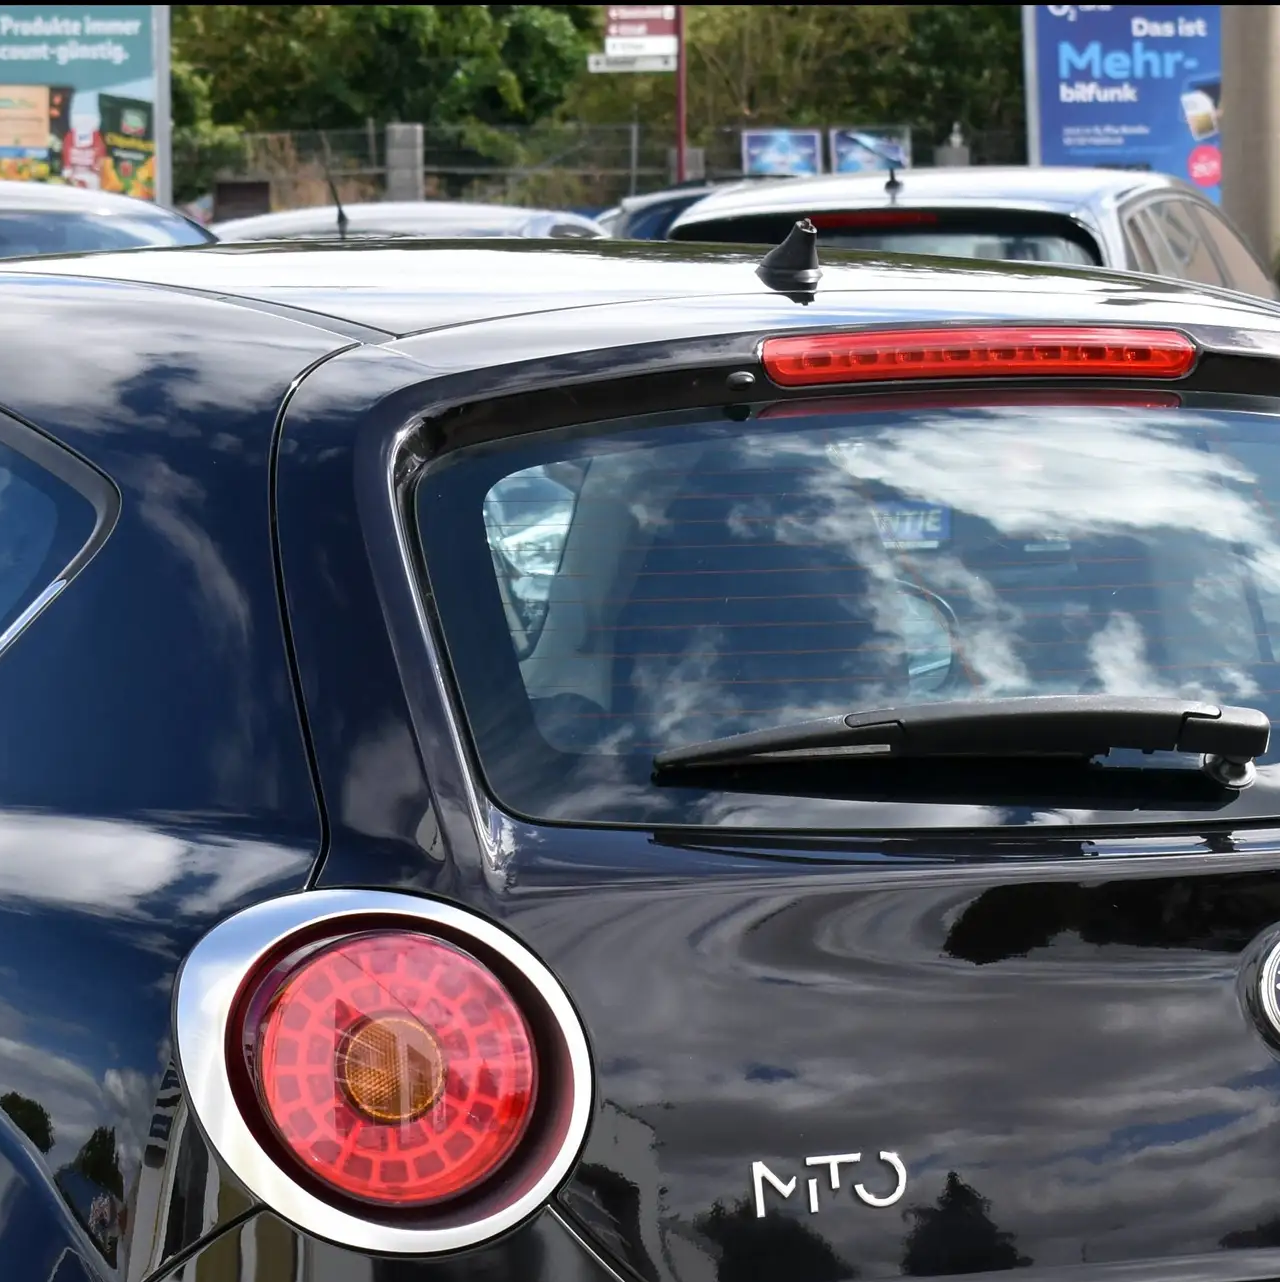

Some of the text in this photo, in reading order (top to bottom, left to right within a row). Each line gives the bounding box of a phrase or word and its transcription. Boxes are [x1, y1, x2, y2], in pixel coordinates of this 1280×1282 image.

[0, 14, 82, 36] Produkte
[83, 13, 142, 36] immer
[1131, 15, 1208, 38] Das ist
[1057, 40, 1200, 80] Mehr-
[1059, 81, 1138, 103] bilfunk
